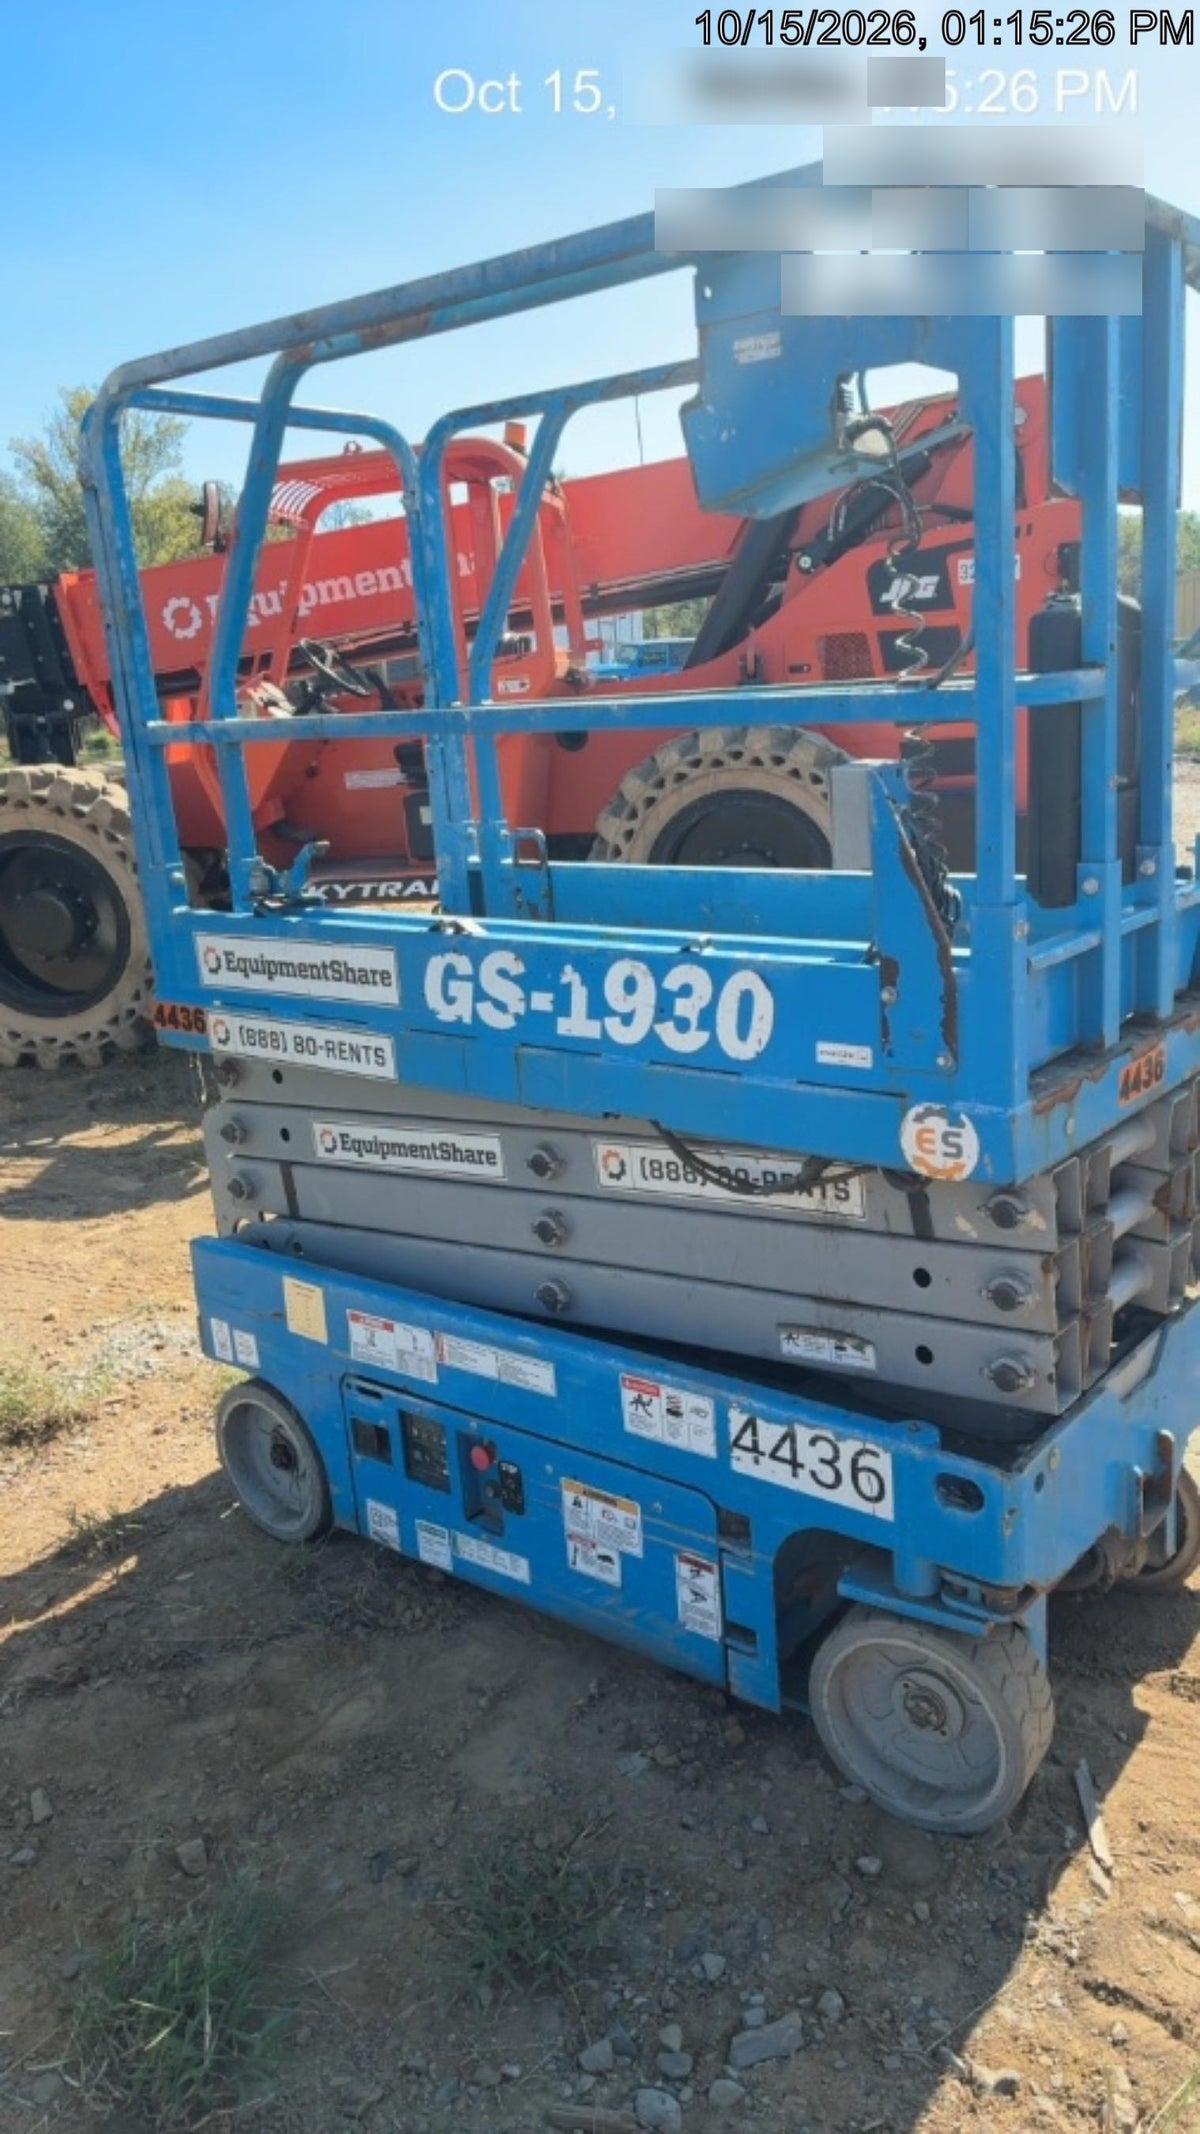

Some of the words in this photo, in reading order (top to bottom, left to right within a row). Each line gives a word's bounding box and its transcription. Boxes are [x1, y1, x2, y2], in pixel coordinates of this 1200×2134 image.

[303, 879, 439, 900] KYTRA
[223, 950, 393, 987] EquipmentShare
[154, 1004, 207, 1034] 4436
[424, 950, 774, 1061] GS-1930
[239, 1025, 288, 1053] (888)
[293, 1035, 387, 1067] 80-RENTS
[339, 1132, 497, 1166] EquipmentShare
[915, 1128, 963, 1159] ES
[732, 1416, 886, 1504] 4436
